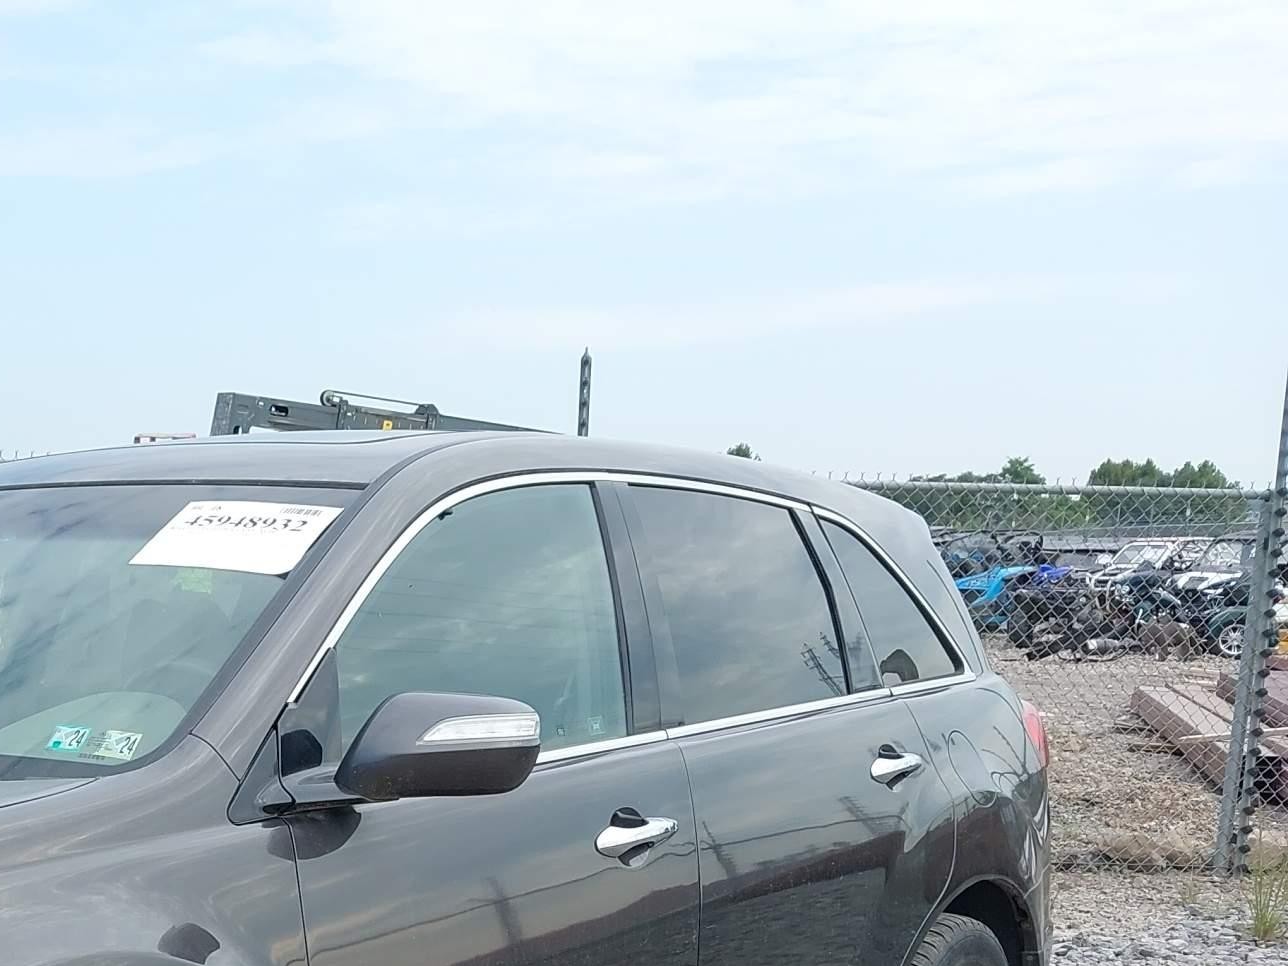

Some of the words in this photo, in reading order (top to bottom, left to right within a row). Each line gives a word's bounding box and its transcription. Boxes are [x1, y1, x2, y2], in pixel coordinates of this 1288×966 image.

[184, 514, 309, 533] 45948932
[68, 729, 87, 748] 24
[119, 736, 138, 755] 24
